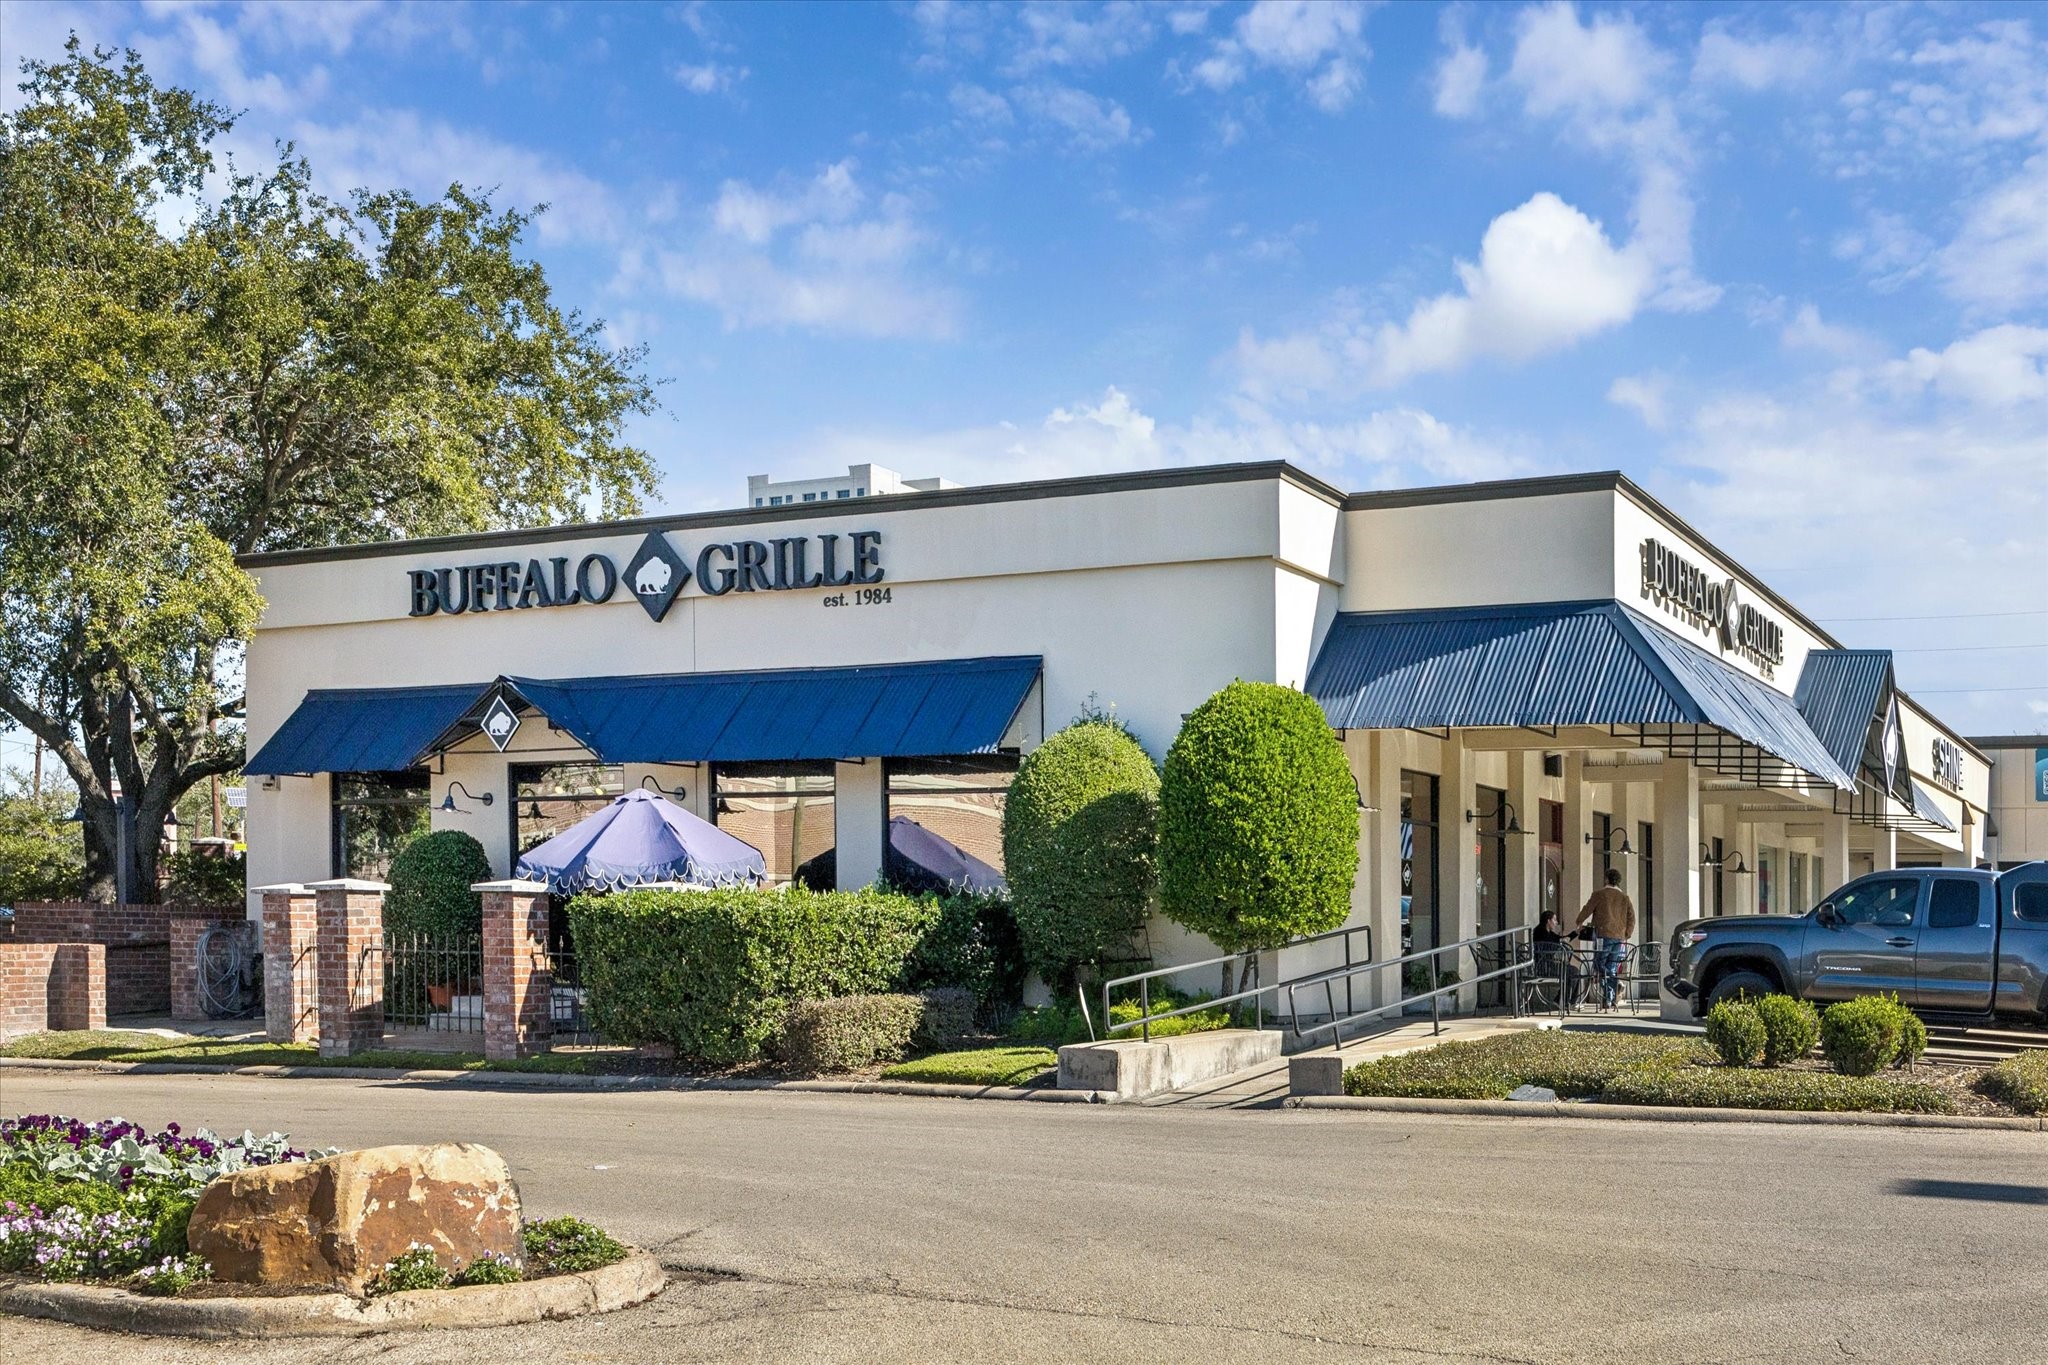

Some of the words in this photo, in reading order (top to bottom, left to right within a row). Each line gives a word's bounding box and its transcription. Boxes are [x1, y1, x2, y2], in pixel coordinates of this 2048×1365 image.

[407, 554, 617, 617] BUFFALO
[696, 531, 886, 596] GRILLE
[823, 592, 849, 607] est.
[855, 587, 892, 605] 1984
[1645, 538, 1724, 628] BUFFALO
[1738, 603, 1783, 666] GRILLE
